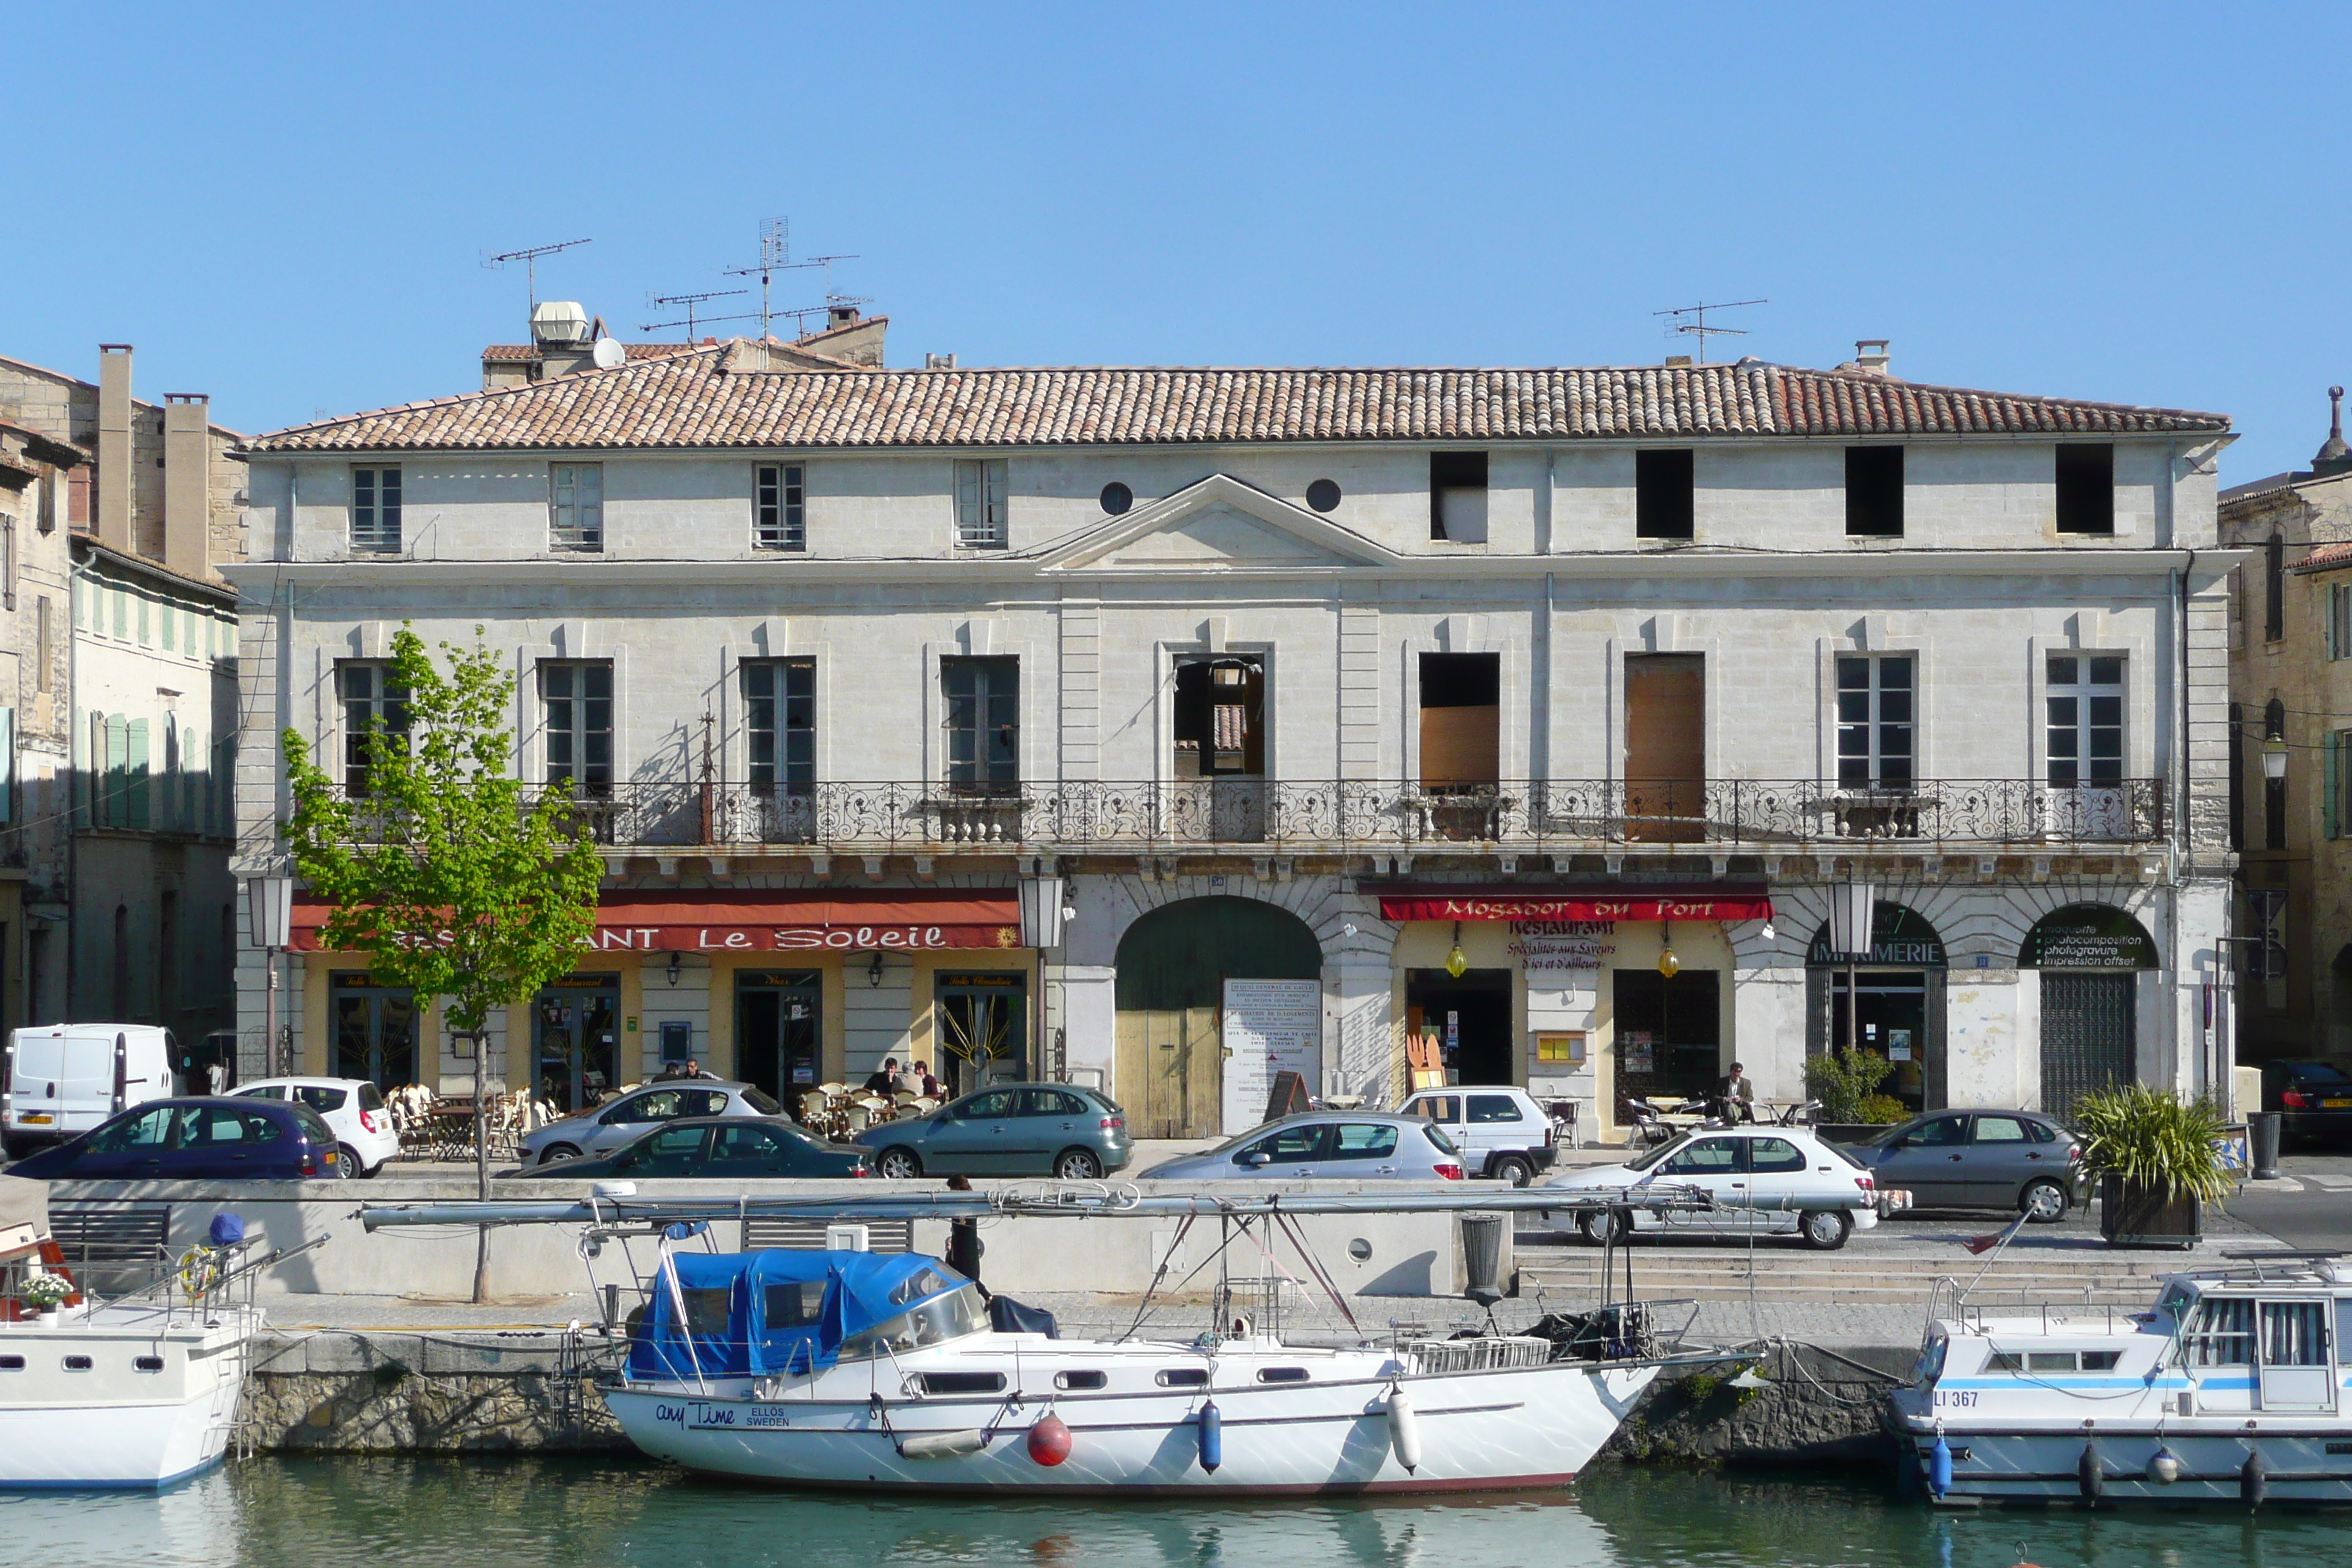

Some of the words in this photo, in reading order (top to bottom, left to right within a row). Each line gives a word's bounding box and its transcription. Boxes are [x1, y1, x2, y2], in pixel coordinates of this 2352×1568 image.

[1444, 899, 1569, 919] Mogador
[1594, 900, 1630, 915] du
[1656, 899, 1714, 915] Port
[1509, 920, 1616, 935] Restaurant
[2045, 925, 2097, 935] maquette
[699, 929, 752, 948] Le
[774, 927, 946, 948] Soleil
[2044, 935, 2142, 946] photocomposition
[1558, 945, 1576, 954] aux
[1580, 942, 1616, 955] Saveurs
[2044, 945, 2119, 957] photogravure
[1545, 958, 1555, 969] et
[2044, 956, 2101, 967] impression
[2104, 956, 2136, 966] offset
[1934, 1391, 1946, 1406] LI
[1952, 1391, 1978, 1407] 367
[656, 1404, 685, 1431] any
[688, 1401, 735, 1425] Time
[752, 1406, 784, 1417] ELLÖS
[747, 1417, 790, 1426] SWEDEN
